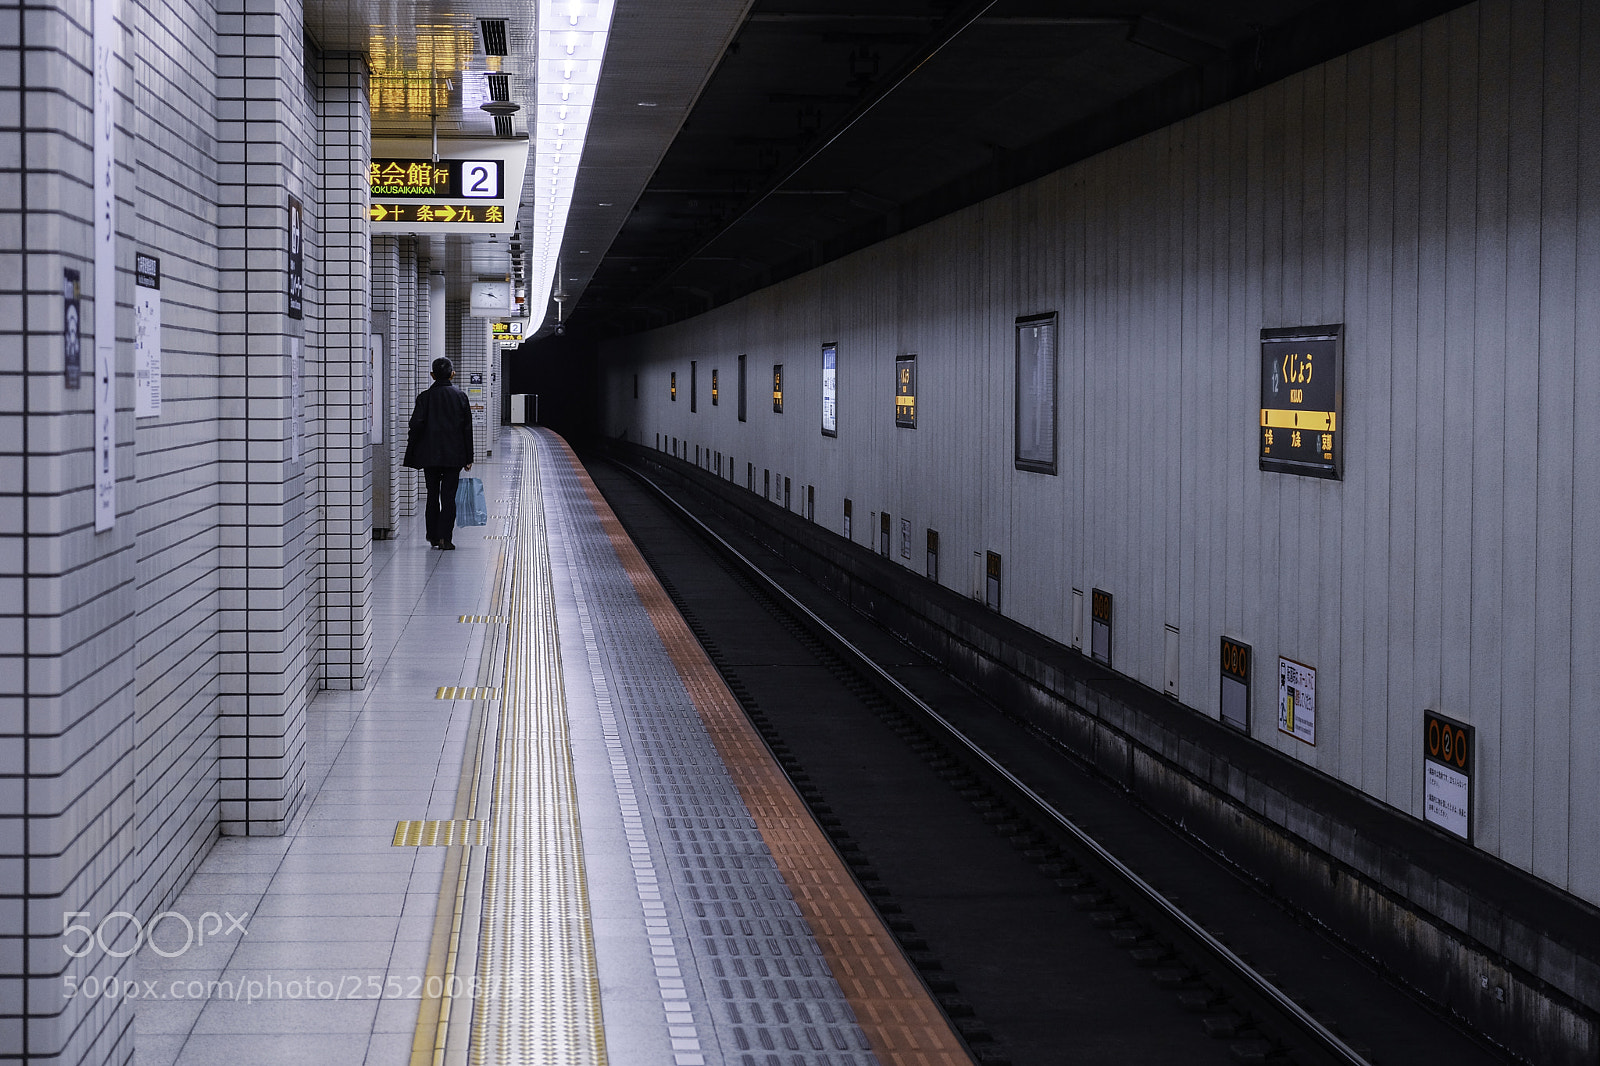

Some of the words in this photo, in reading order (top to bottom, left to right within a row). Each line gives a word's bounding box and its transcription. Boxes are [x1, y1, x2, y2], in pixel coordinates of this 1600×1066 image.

[470, 166, 489, 192] 2
[1282, 353, 1313, 384] くじょう
